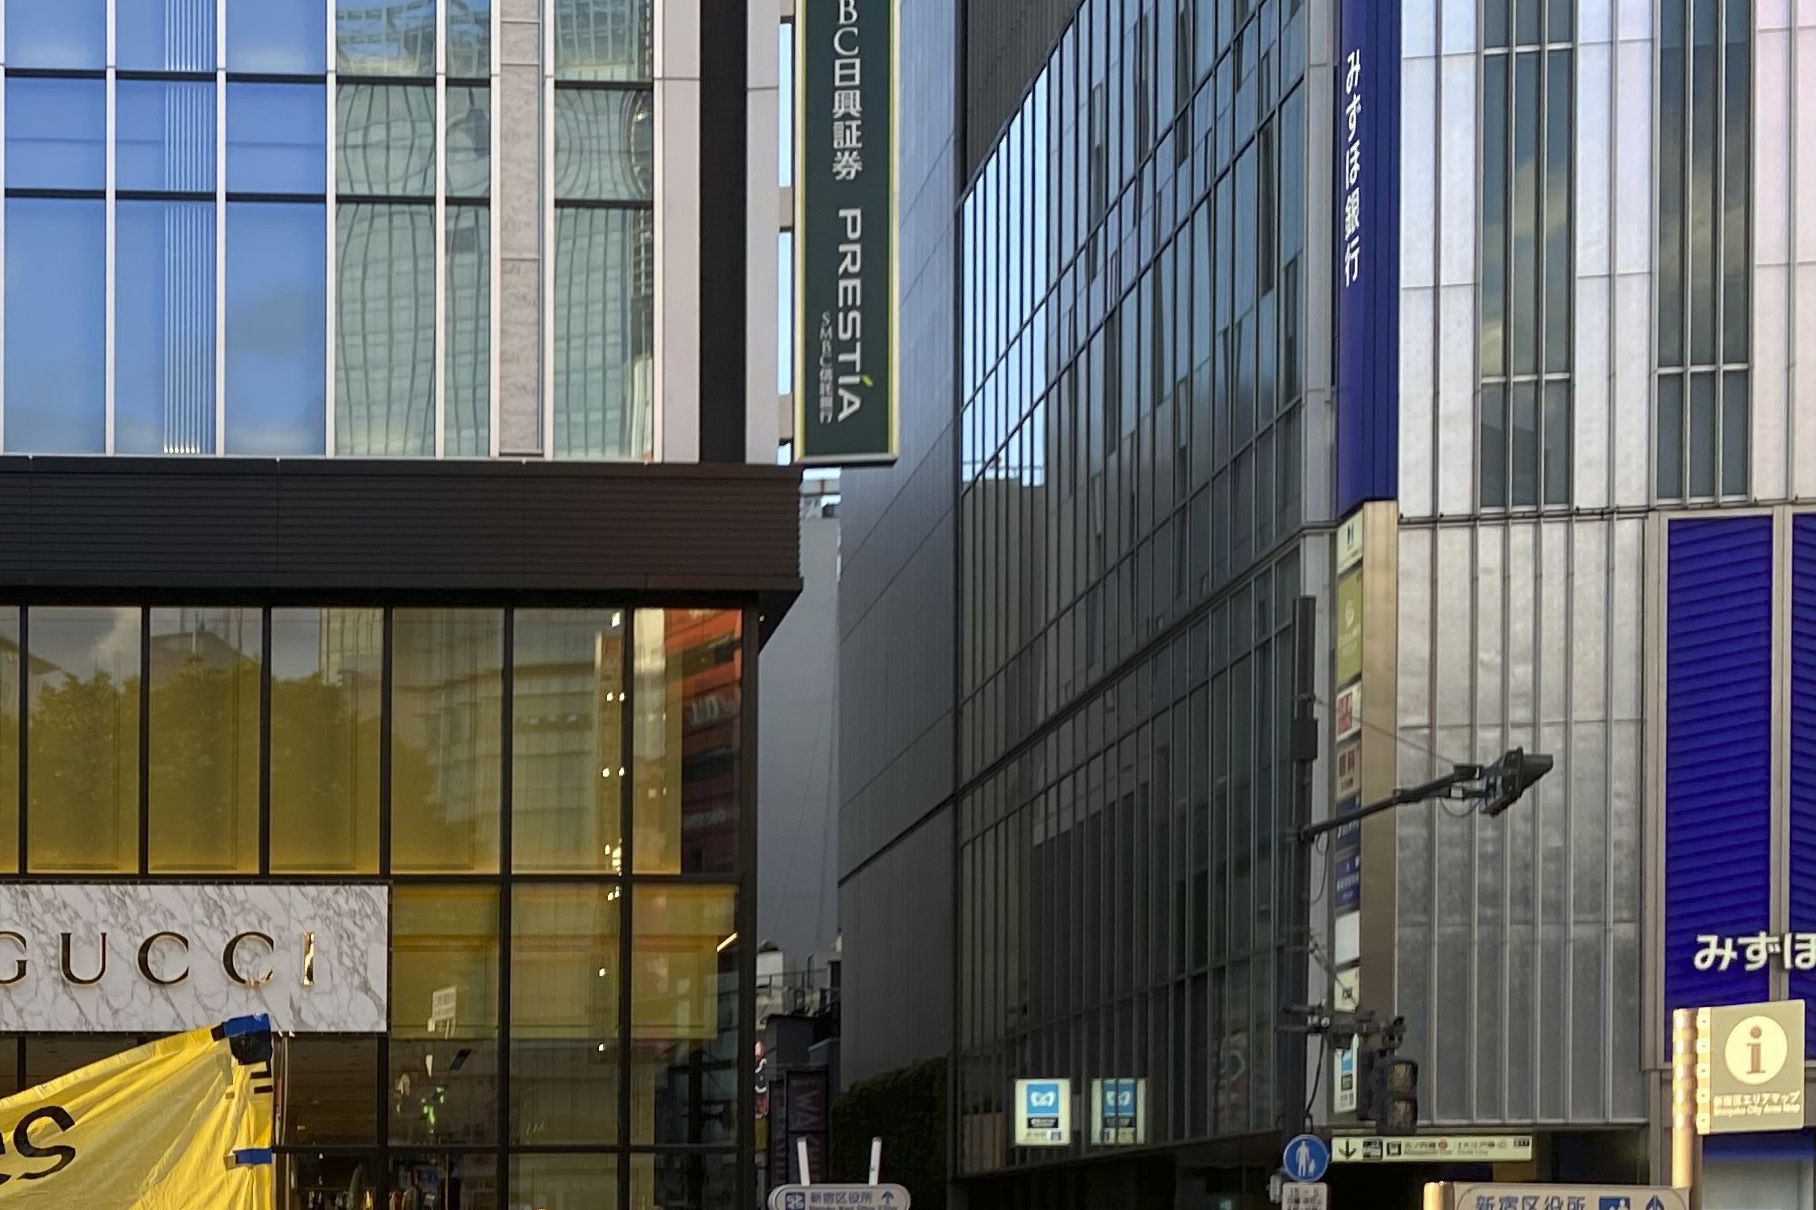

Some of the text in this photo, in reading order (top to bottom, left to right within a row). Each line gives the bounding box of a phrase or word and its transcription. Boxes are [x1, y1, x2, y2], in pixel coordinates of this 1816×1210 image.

[1345, 48, 1362, 288] みずほ銀行
